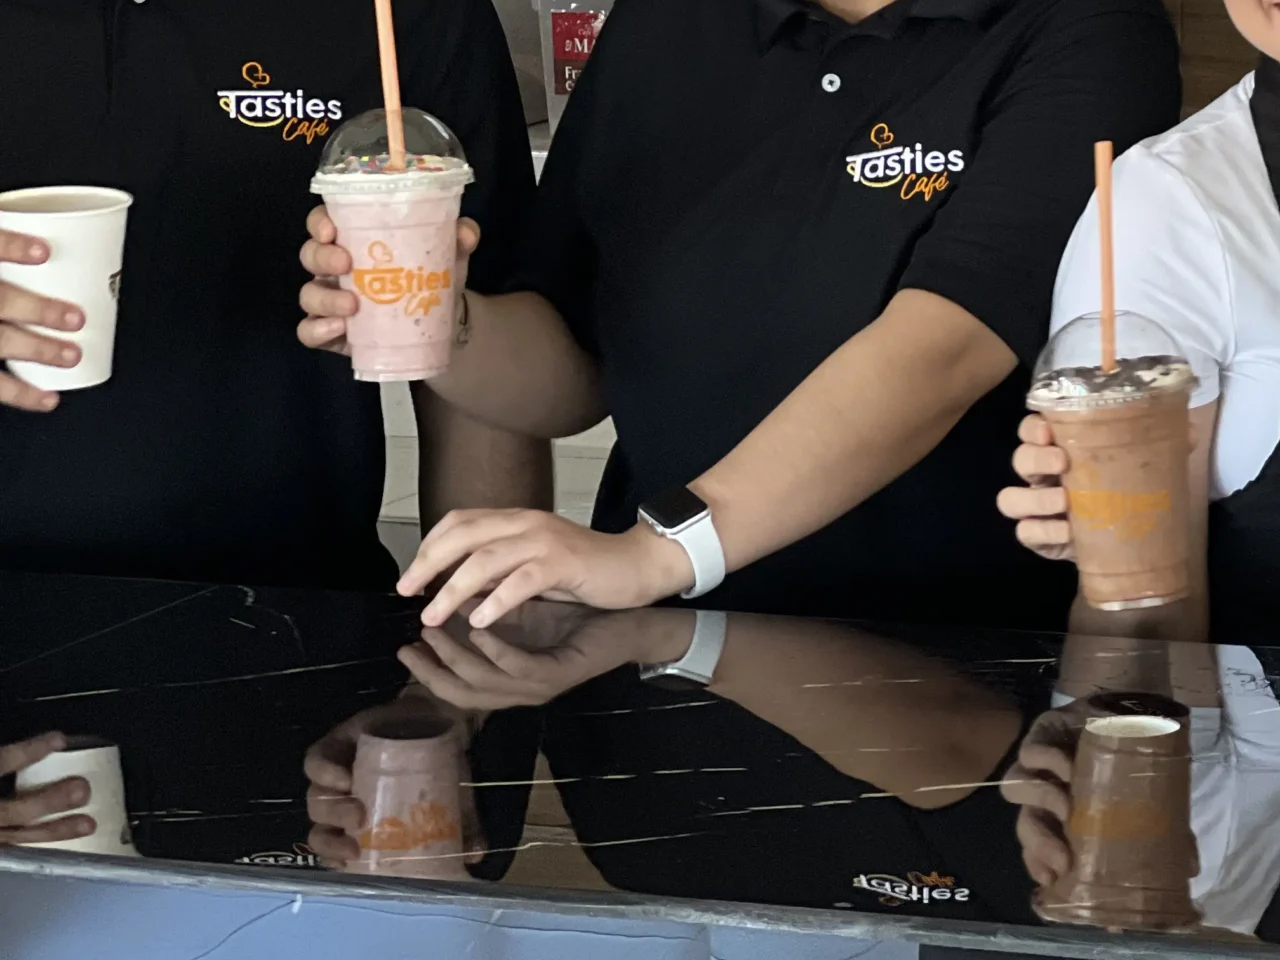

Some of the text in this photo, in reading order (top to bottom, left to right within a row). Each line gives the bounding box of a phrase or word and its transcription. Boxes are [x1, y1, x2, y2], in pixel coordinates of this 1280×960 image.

[217, 90, 343, 120] Tasties
[282, 118, 329, 145] Café
[846, 142, 965, 182] Tasties
[900, 171, 950, 201] Café
